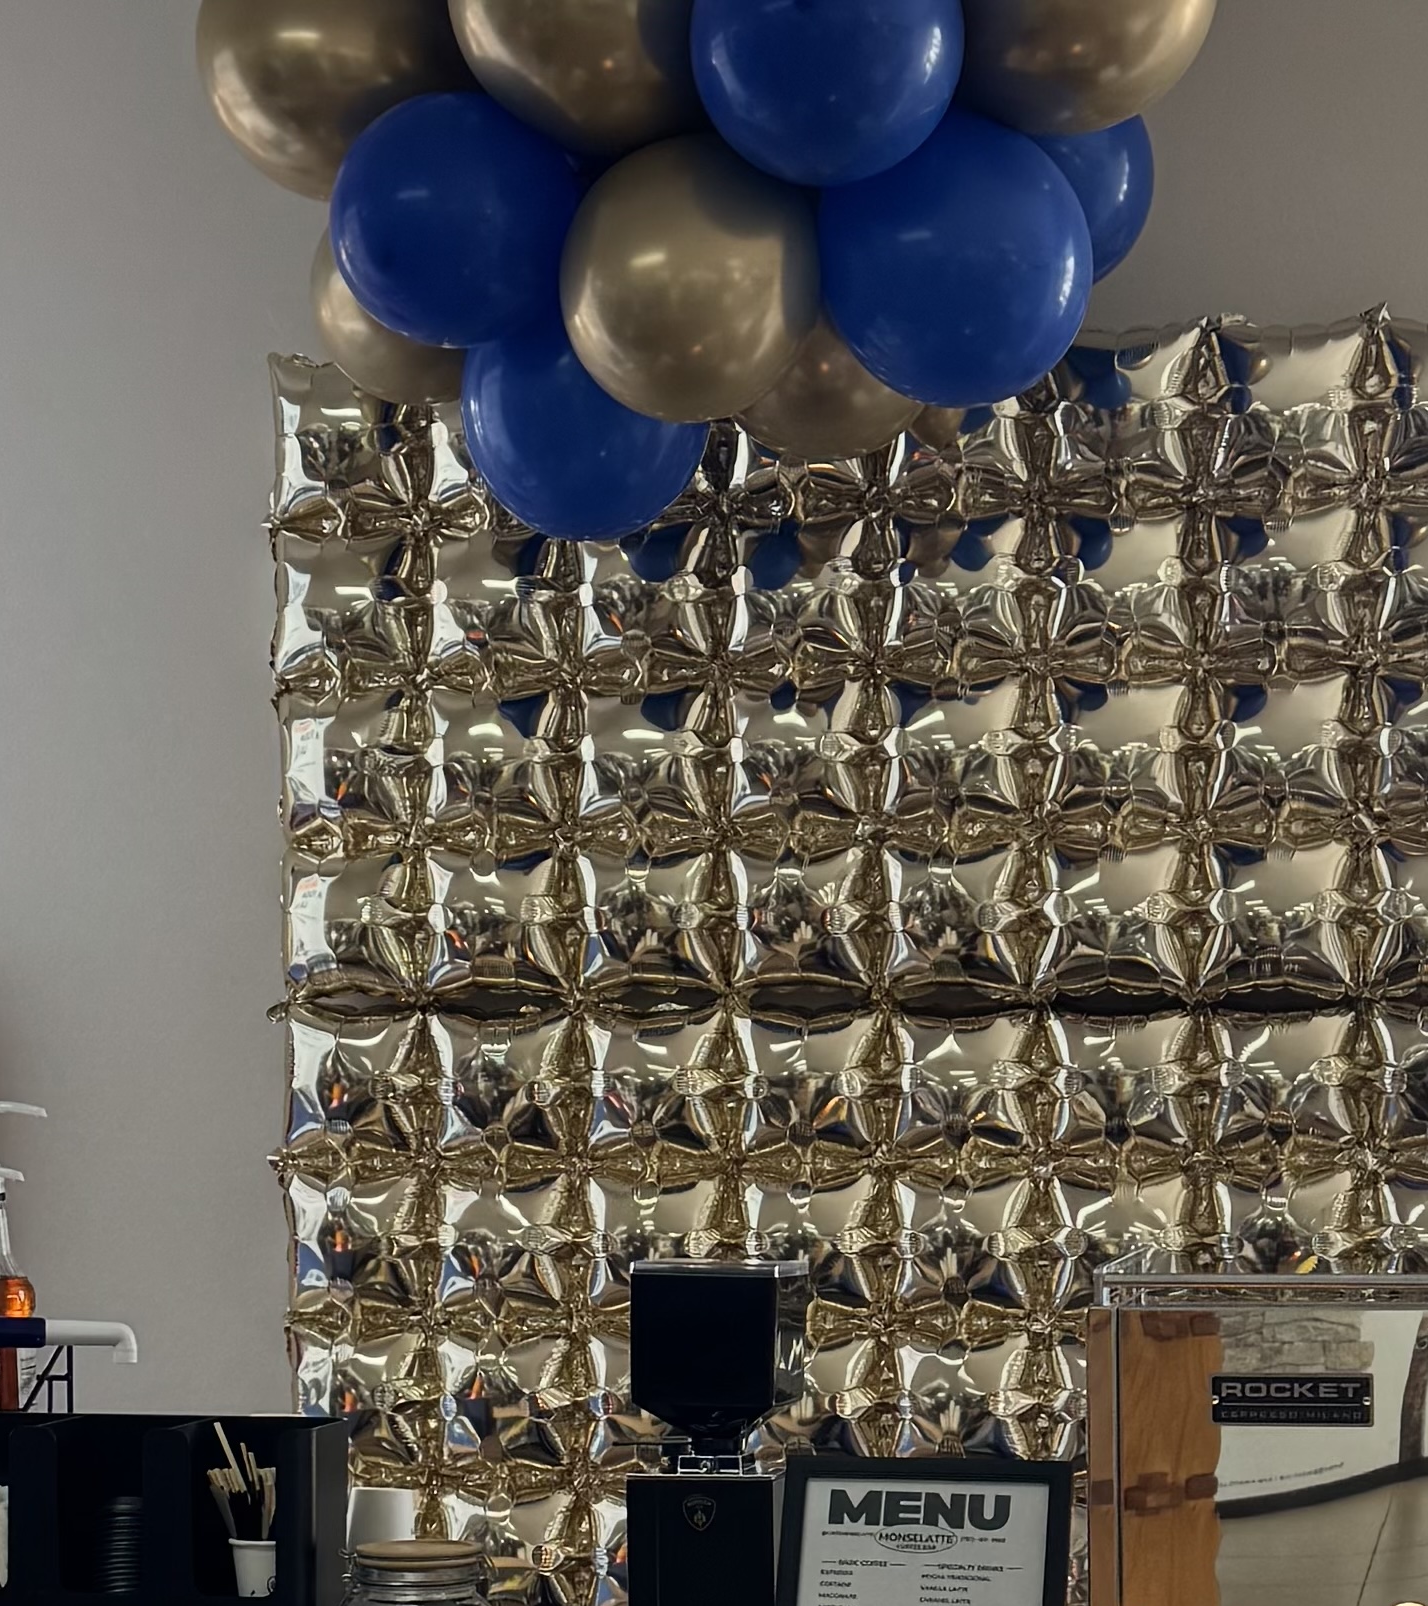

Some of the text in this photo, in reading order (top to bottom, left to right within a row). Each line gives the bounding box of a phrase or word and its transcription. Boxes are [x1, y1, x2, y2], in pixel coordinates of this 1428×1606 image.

[1221, 1382, 1361, 1398] ROCKET
[828, 1489, 1012, 1531] MENU
[879, 1532, 953, 1544] MONSELATTE
